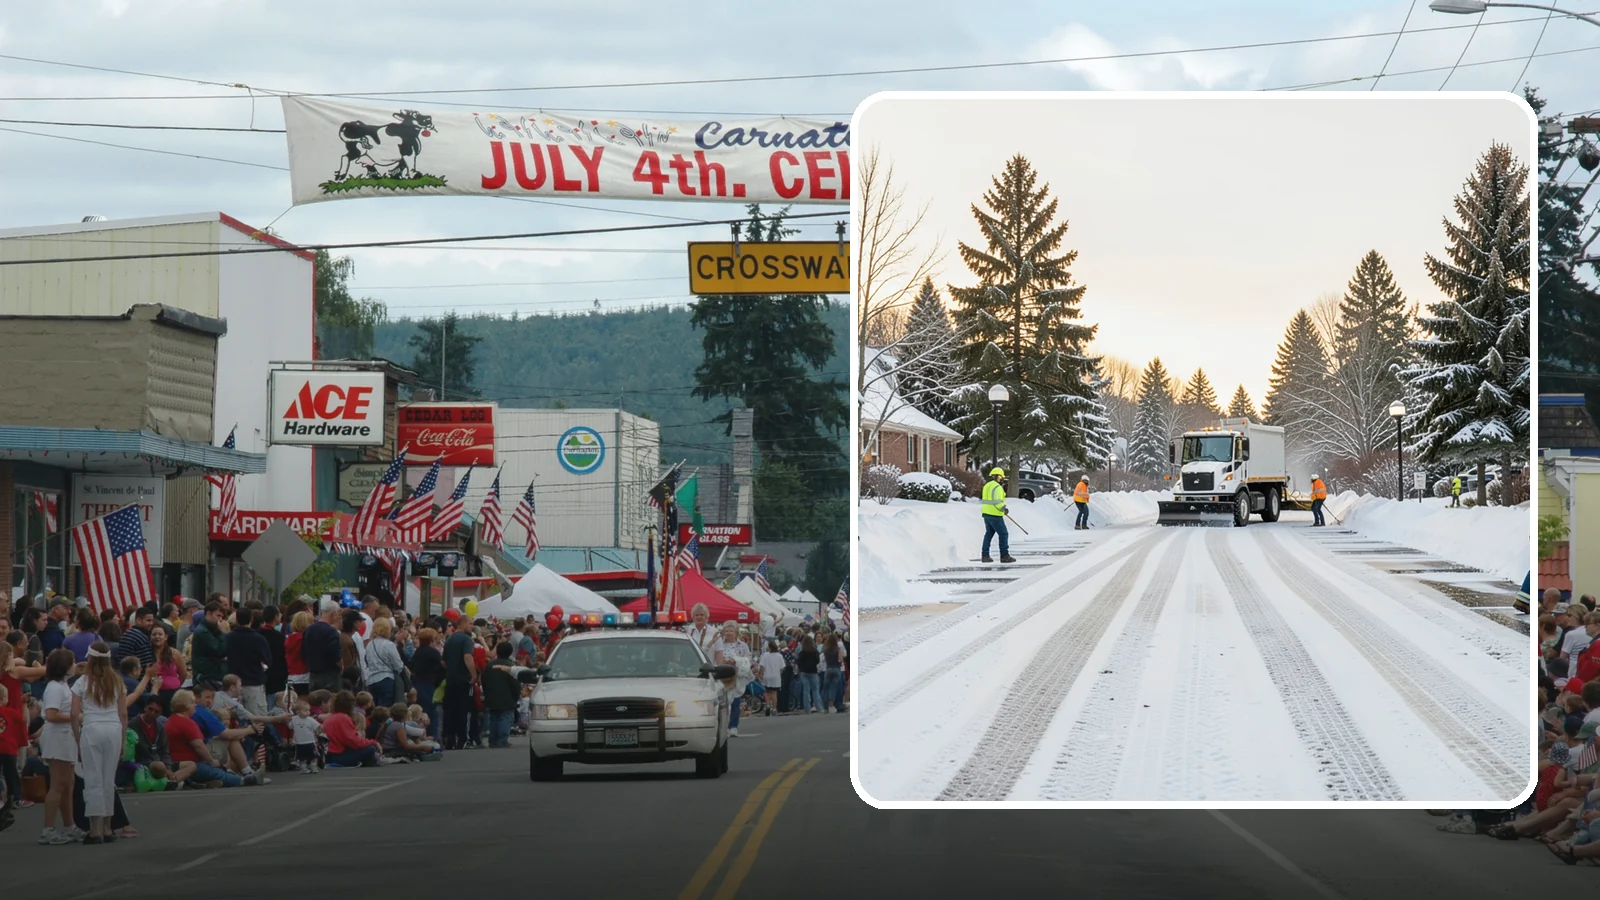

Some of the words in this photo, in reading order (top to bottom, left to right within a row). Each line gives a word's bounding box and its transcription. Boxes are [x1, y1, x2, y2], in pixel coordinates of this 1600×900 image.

[481, 141, 605, 192] JULY
[632, 150, 746, 198] 4th.
[697, 254, 850, 280] CROSSWA
[283, 380, 373, 419] ACE
[406, 409, 452, 422] CEDAR
[461, 409, 485, 422] LOG
[283, 421, 370, 436] Hardware
[95, 485, 124, 494] Vincent
[126, 486, 136, 494] de
[138, 486, 155, 495] Paul
[699, 535, 730, 543] GLASS
